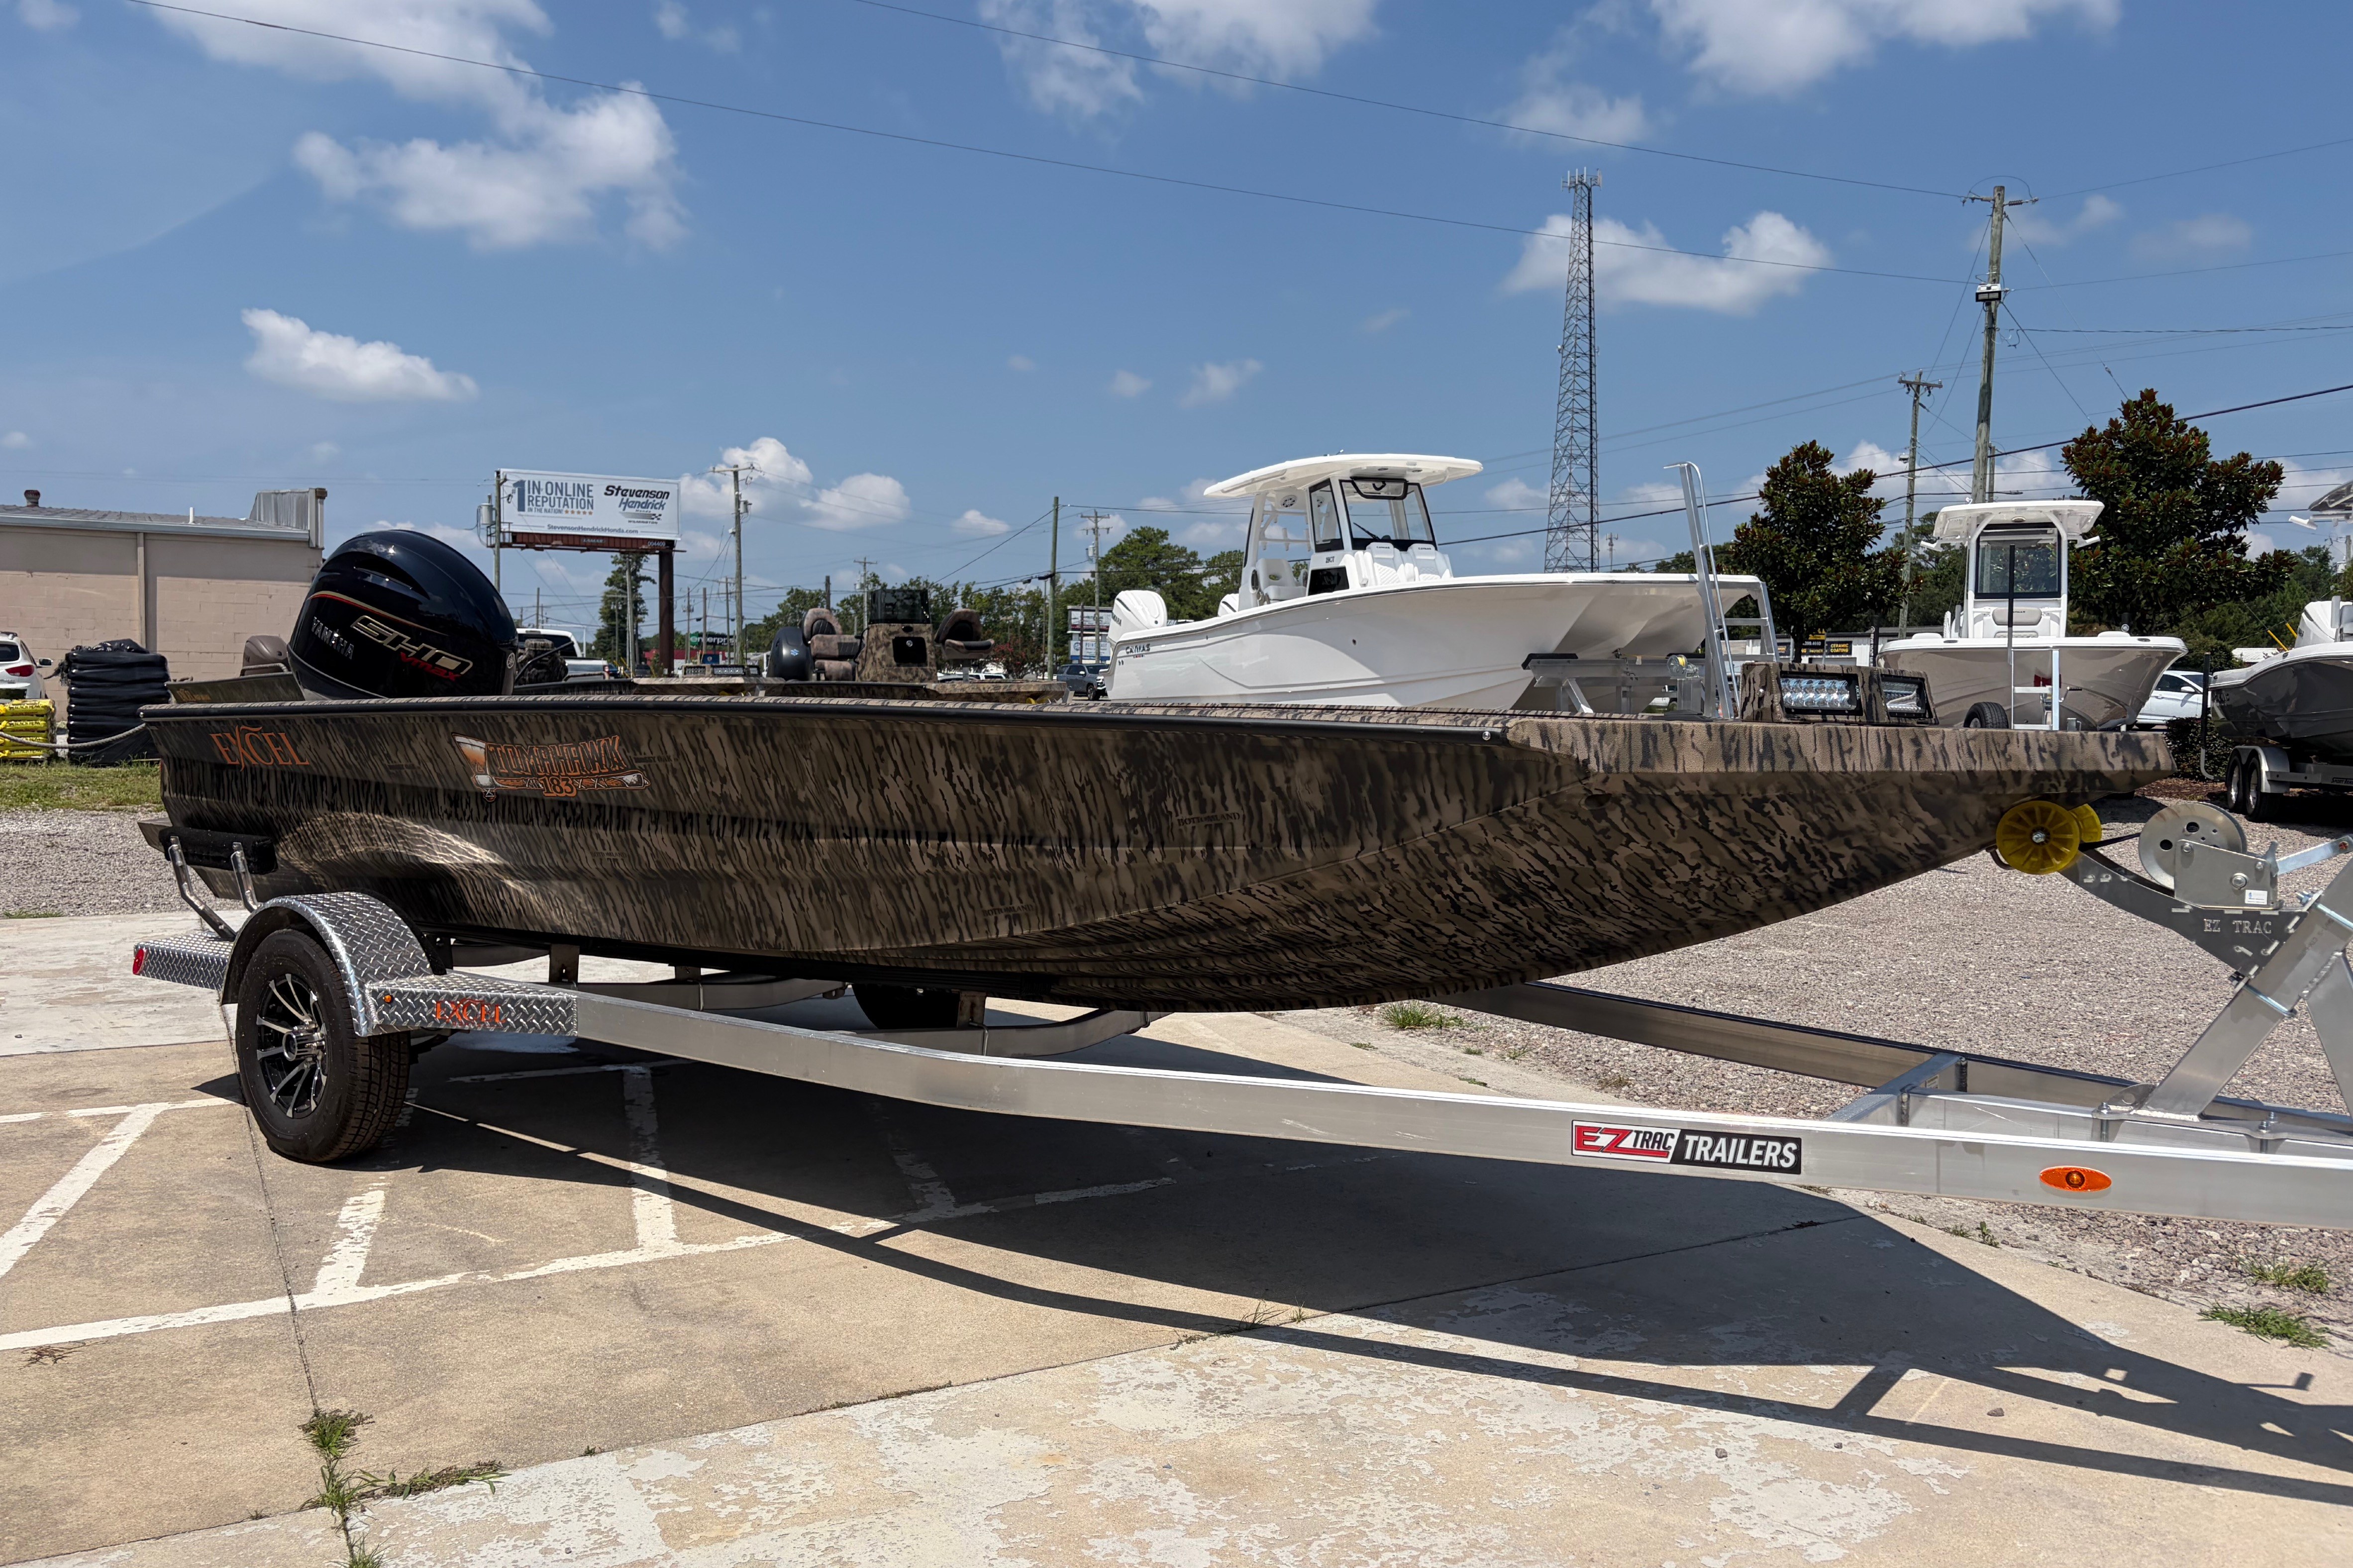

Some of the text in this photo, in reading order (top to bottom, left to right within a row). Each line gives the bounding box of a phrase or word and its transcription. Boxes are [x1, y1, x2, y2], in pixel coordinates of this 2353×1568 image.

[528, 480, 594, 497] IN ONLINE
[604, 485, 670, 499] Stevenson
[527, 495, 594, 510] REPUTATION
[618, 497, 666, 511] Hendrick
[547, 524, 638, 534] StevensonHendrickHonda.com
[312, 616, 354, 660] YAMAHA
[350, 615, 473, 675] SHO
[209, 725, 310, 772] EXCEL
[487, 735, 628, 776] TOMAHAWK
[542, 777, 576, 796] 183
[1177, 812, 1240, 826] BOTTOMLAND
[2203, 918, 2272, 934] EZ TRAC
[436, 997, 507, 1026] EXCEL
[1575, 1125, 1798, 1168] EZ TRAC TRAILERS
